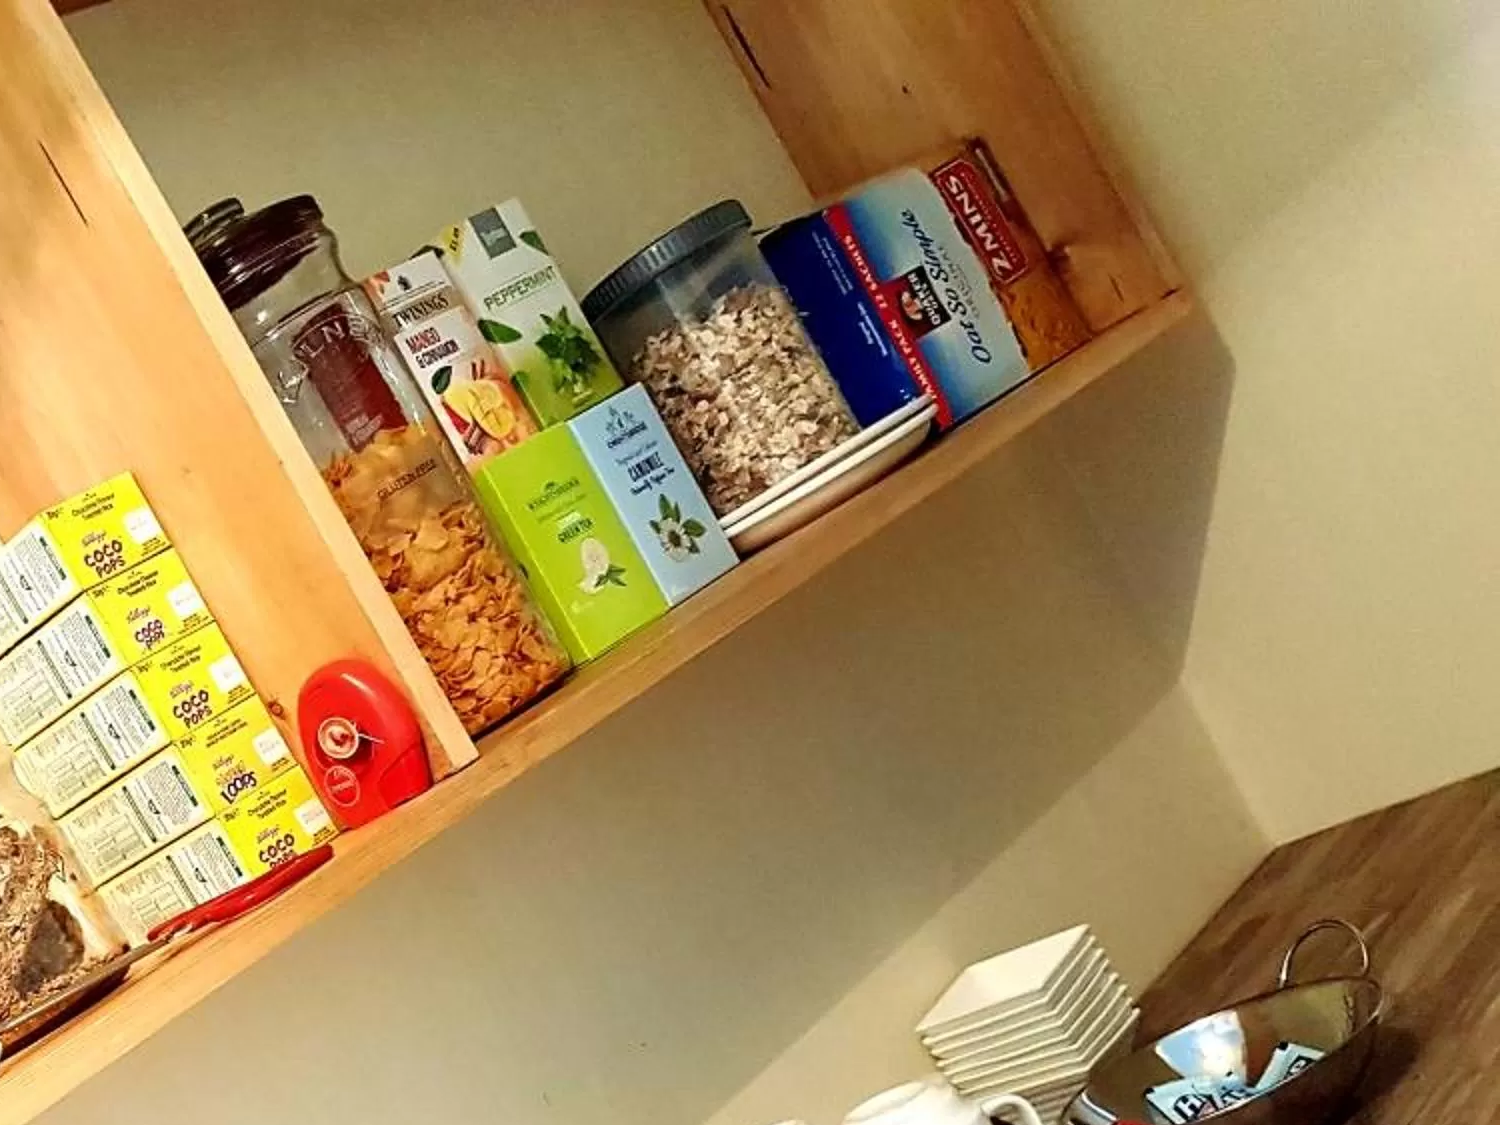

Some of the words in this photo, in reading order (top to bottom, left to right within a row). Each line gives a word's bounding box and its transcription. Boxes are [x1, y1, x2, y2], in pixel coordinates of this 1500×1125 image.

[945, 175, 1000, 252] MINS
[901, 207, 949, 283] Simple
[990, 253, 1014, 274] 2
[483, 265, 557, 311] PEPPERMINT
[907, 271, 942, 326] QUAKER
[944, 287, 968, 317] So
[392, 292, 450, 328] TWININGS
[888, 319, 913, 354] PACK
[960, 318, 993, 365] Oat
[84, 540, 122, 567] COCO
[134, 619, 162, 643] COCO
[173, 689, 209, 718] COCO
[220, 771, 257, 804] LOOPS
[259, 833, 295, 863] COCO
